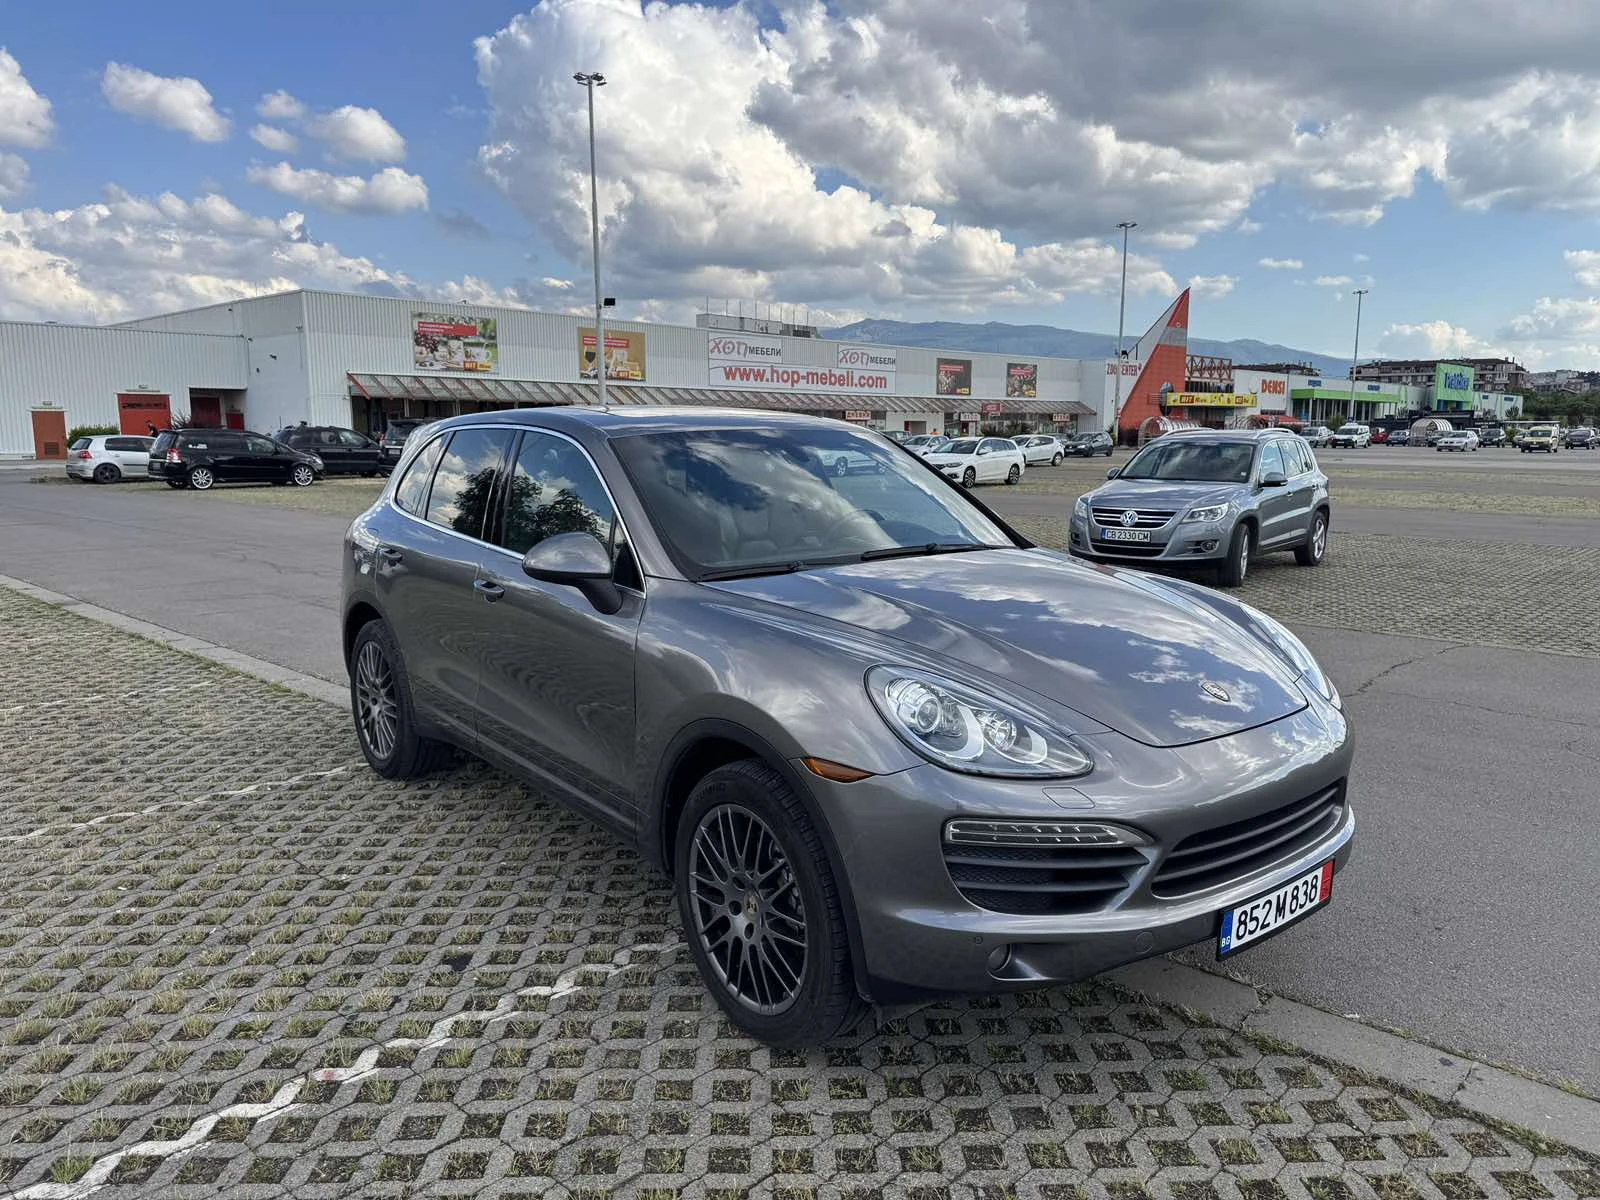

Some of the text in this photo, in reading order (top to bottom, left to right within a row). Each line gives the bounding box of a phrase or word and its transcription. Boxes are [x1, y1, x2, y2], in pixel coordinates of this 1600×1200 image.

[749, 346, 781, 357] МЕБЕЛИ
[870, 356, 896, 366] МЕБЕЛИ
[724, 365, 887, 389] www.hop-mebeli.com
[1261, 379, 1285, 395] DENSI
